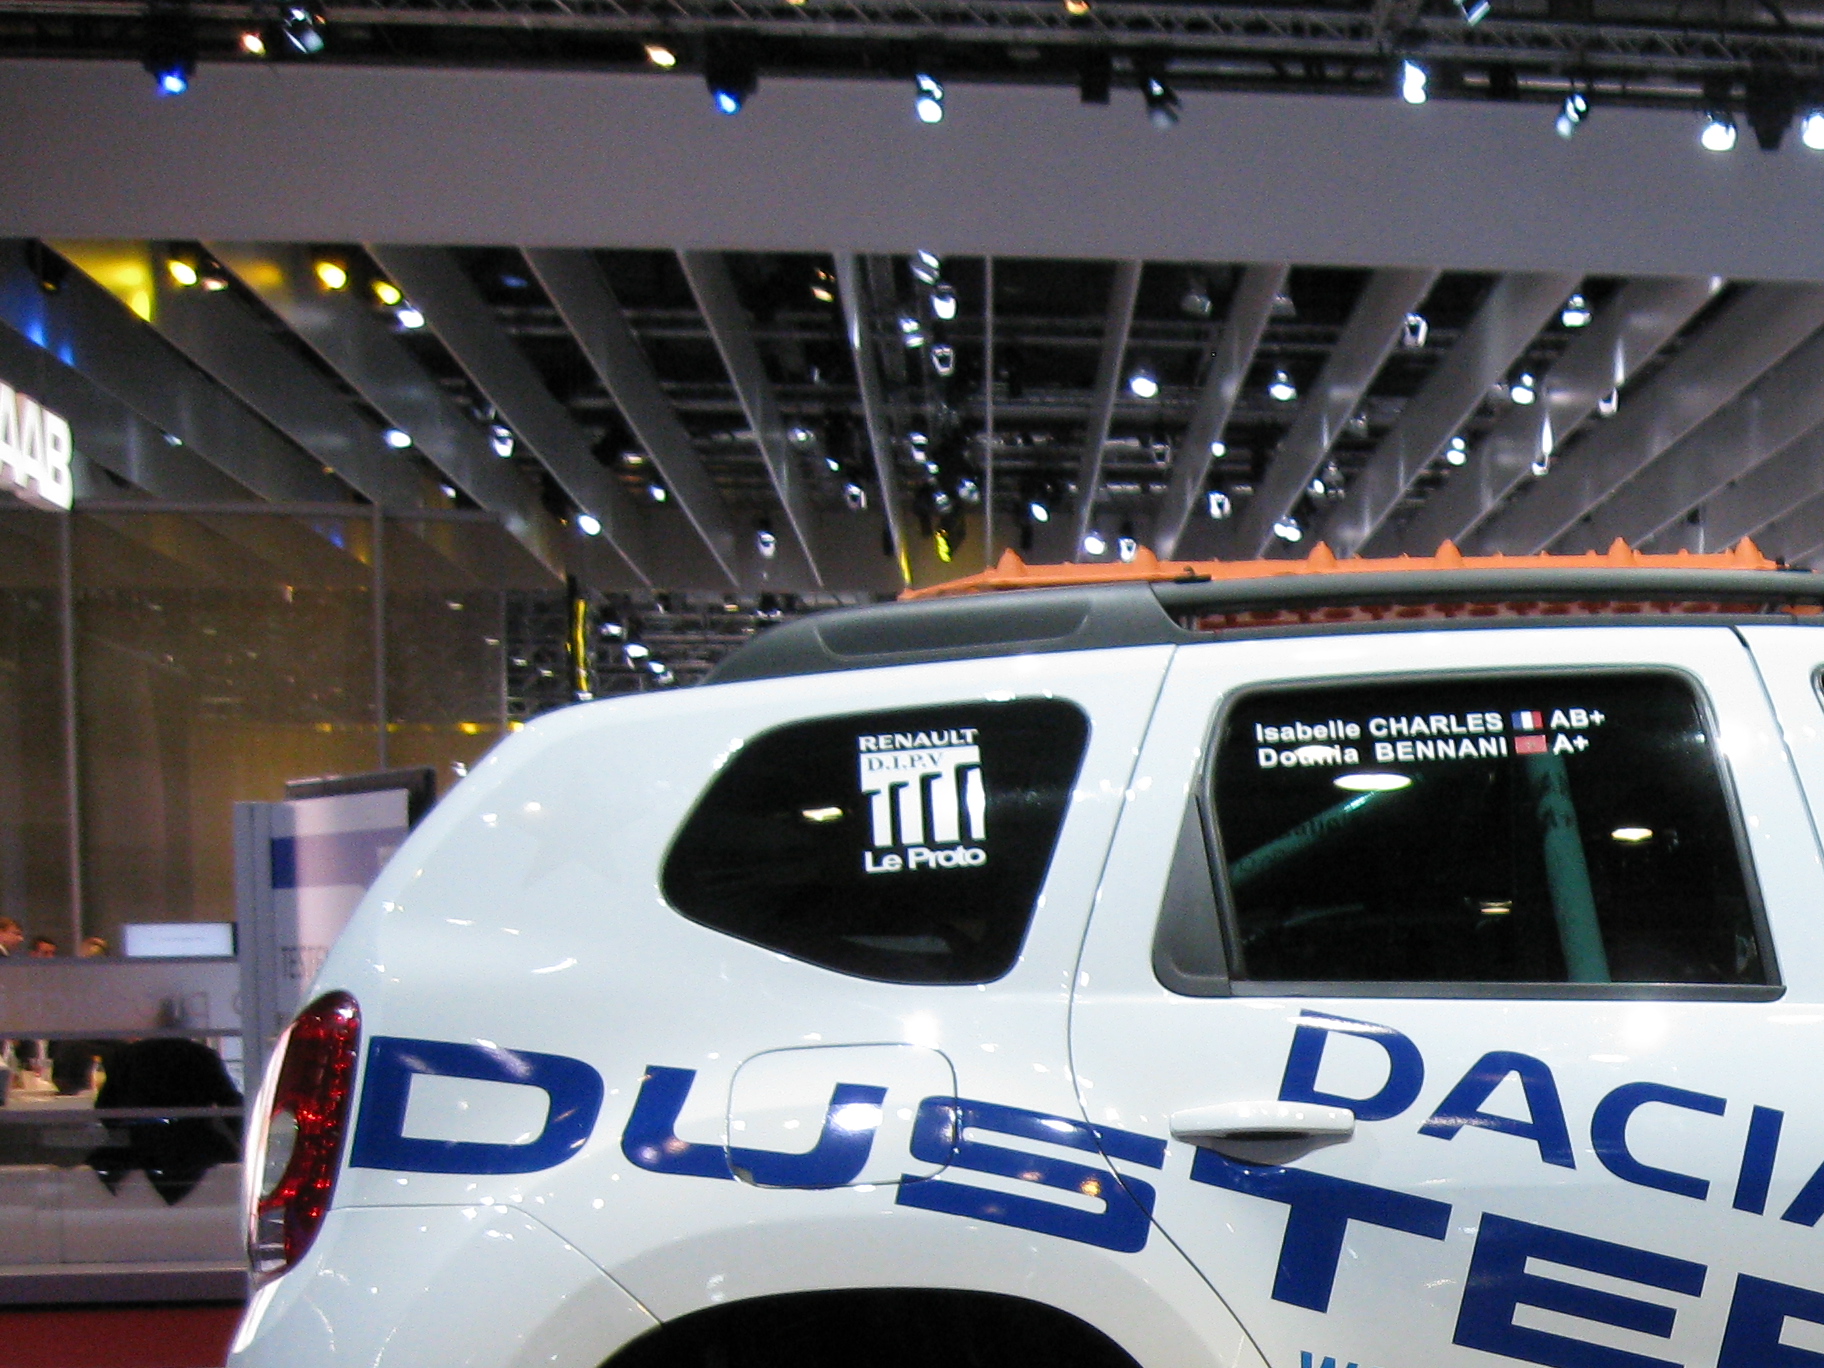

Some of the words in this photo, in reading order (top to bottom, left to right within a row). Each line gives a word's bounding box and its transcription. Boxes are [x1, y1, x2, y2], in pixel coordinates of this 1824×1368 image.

[1255, 719, 1361, 743] Isabelle
[1368, 711, 1504, 738] CHARLES
[1549, 707, 1606, 730] AB+
[858, 729, 980, 752] RENAULT
[1374, 736, 1509, 763] BENNANI
[1552, 733, 1590, 755] A+
[864, 850, 903, 874] Le
[907, 846, 988, 870] Proto
